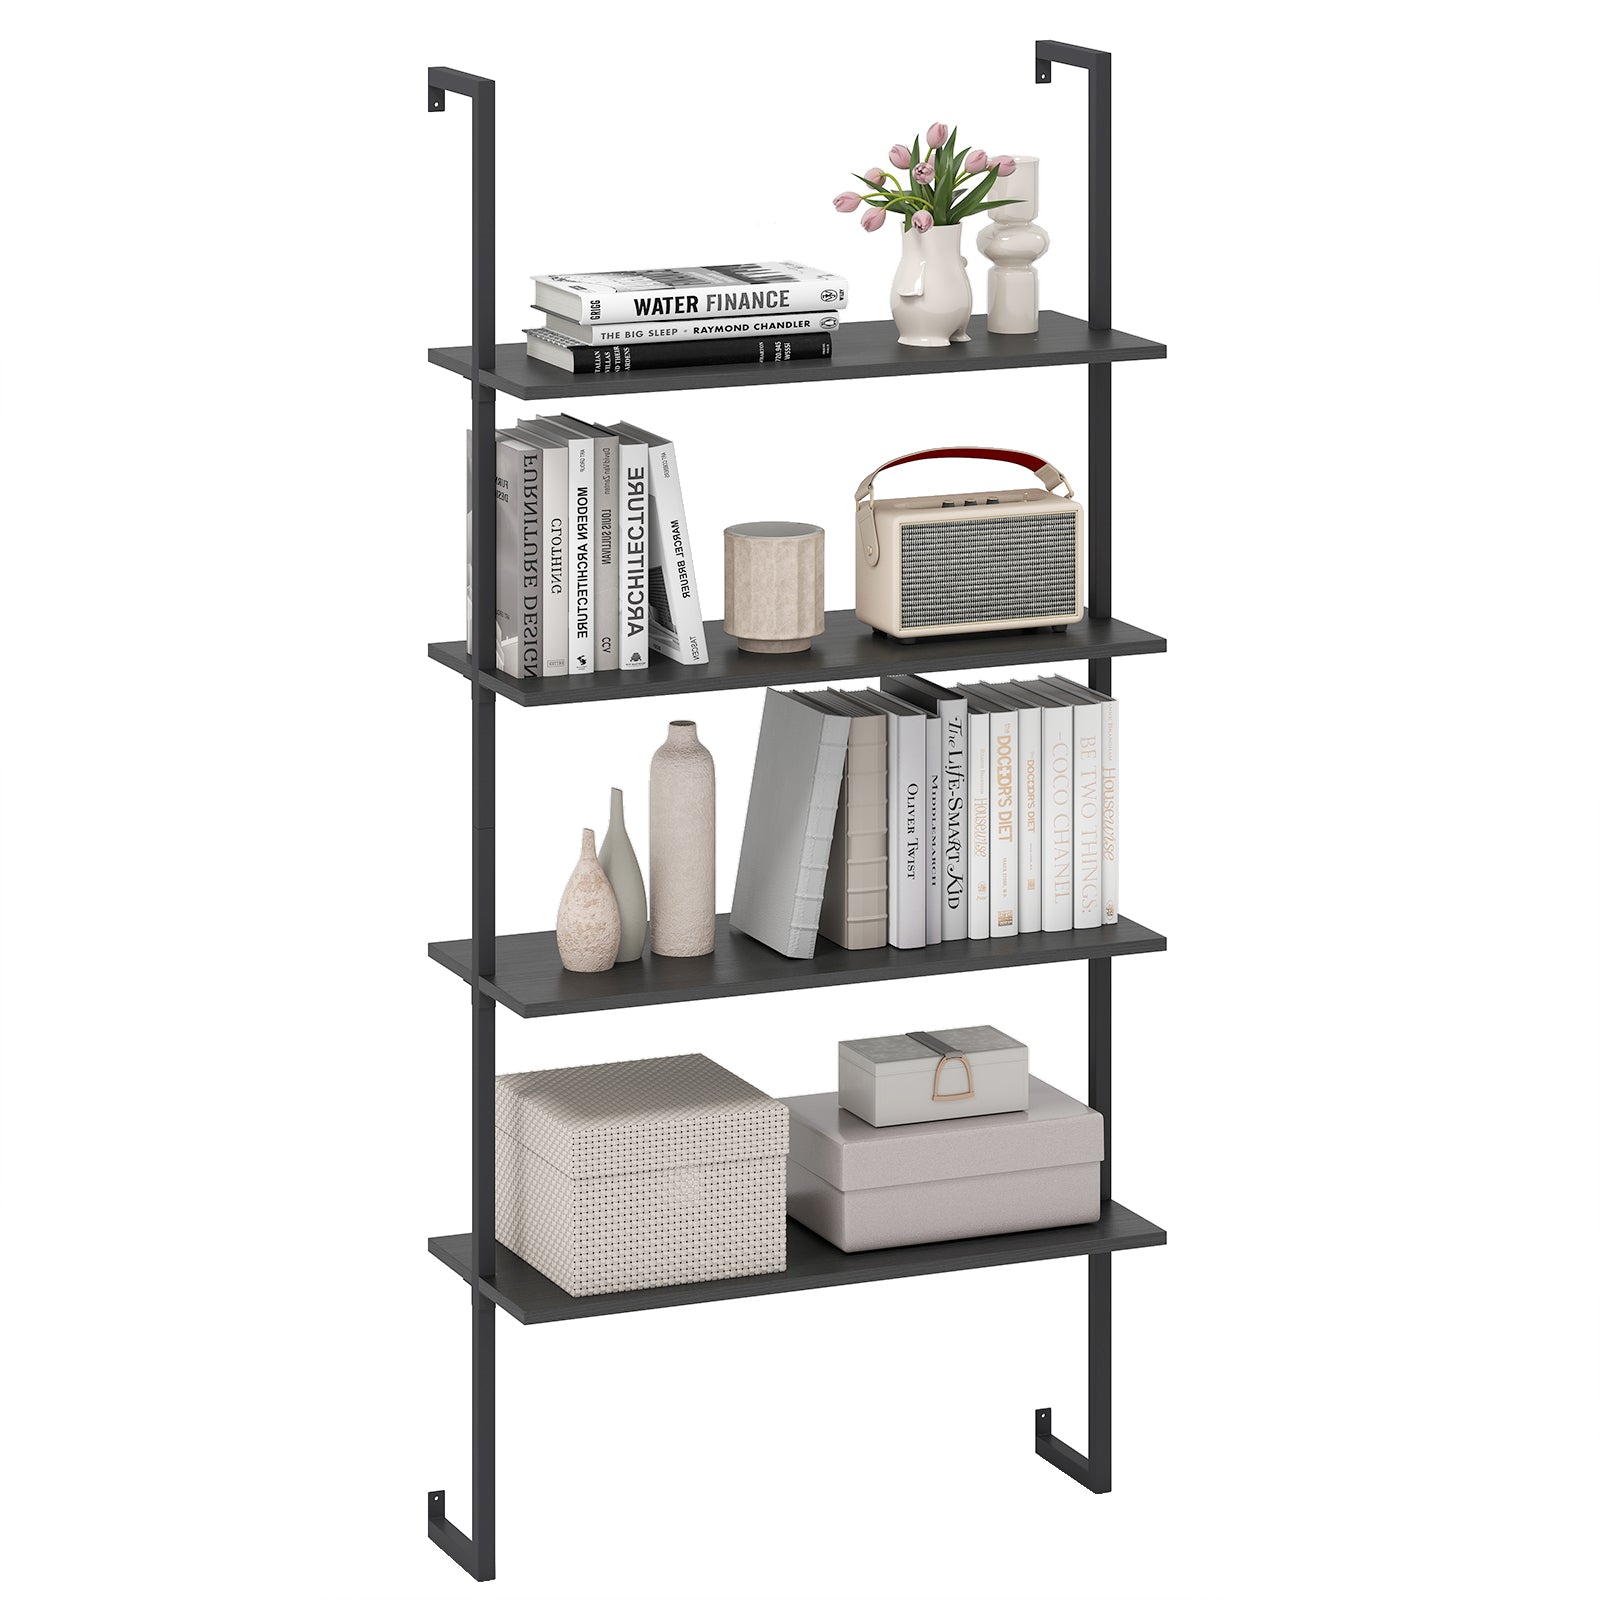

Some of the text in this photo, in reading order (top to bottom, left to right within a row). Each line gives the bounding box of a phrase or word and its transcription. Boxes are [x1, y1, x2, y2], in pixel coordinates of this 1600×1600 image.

[590, 299, 601, 321] GRIGG
[634, 289, 790, 317] WATER FINANCE
[600, 327, 679, 341] THE BIG SLEEP
[693, 319, 812, 336] RAYMOND CHANDLER
[593, 350, 602, 374] TALIAN
[622, 346, 632, 372] ARDENS
[948, 716, 963, 748] The
[973, 797, 988, 858] Housewise
[998, 810, 1013, 843] DIET
[1027, 810, 1036, 833] DIET
[1051, 741, 1071, 904] COCO CHANEL
[1080, 735, 1098, 913] BE TWO THINGS:
[1102, 766, 1116, 861] Housewise
[907, 783, 919, 880] OLIVER TWIST
[931, 775, 939, 886] MIDDLEMARCH
